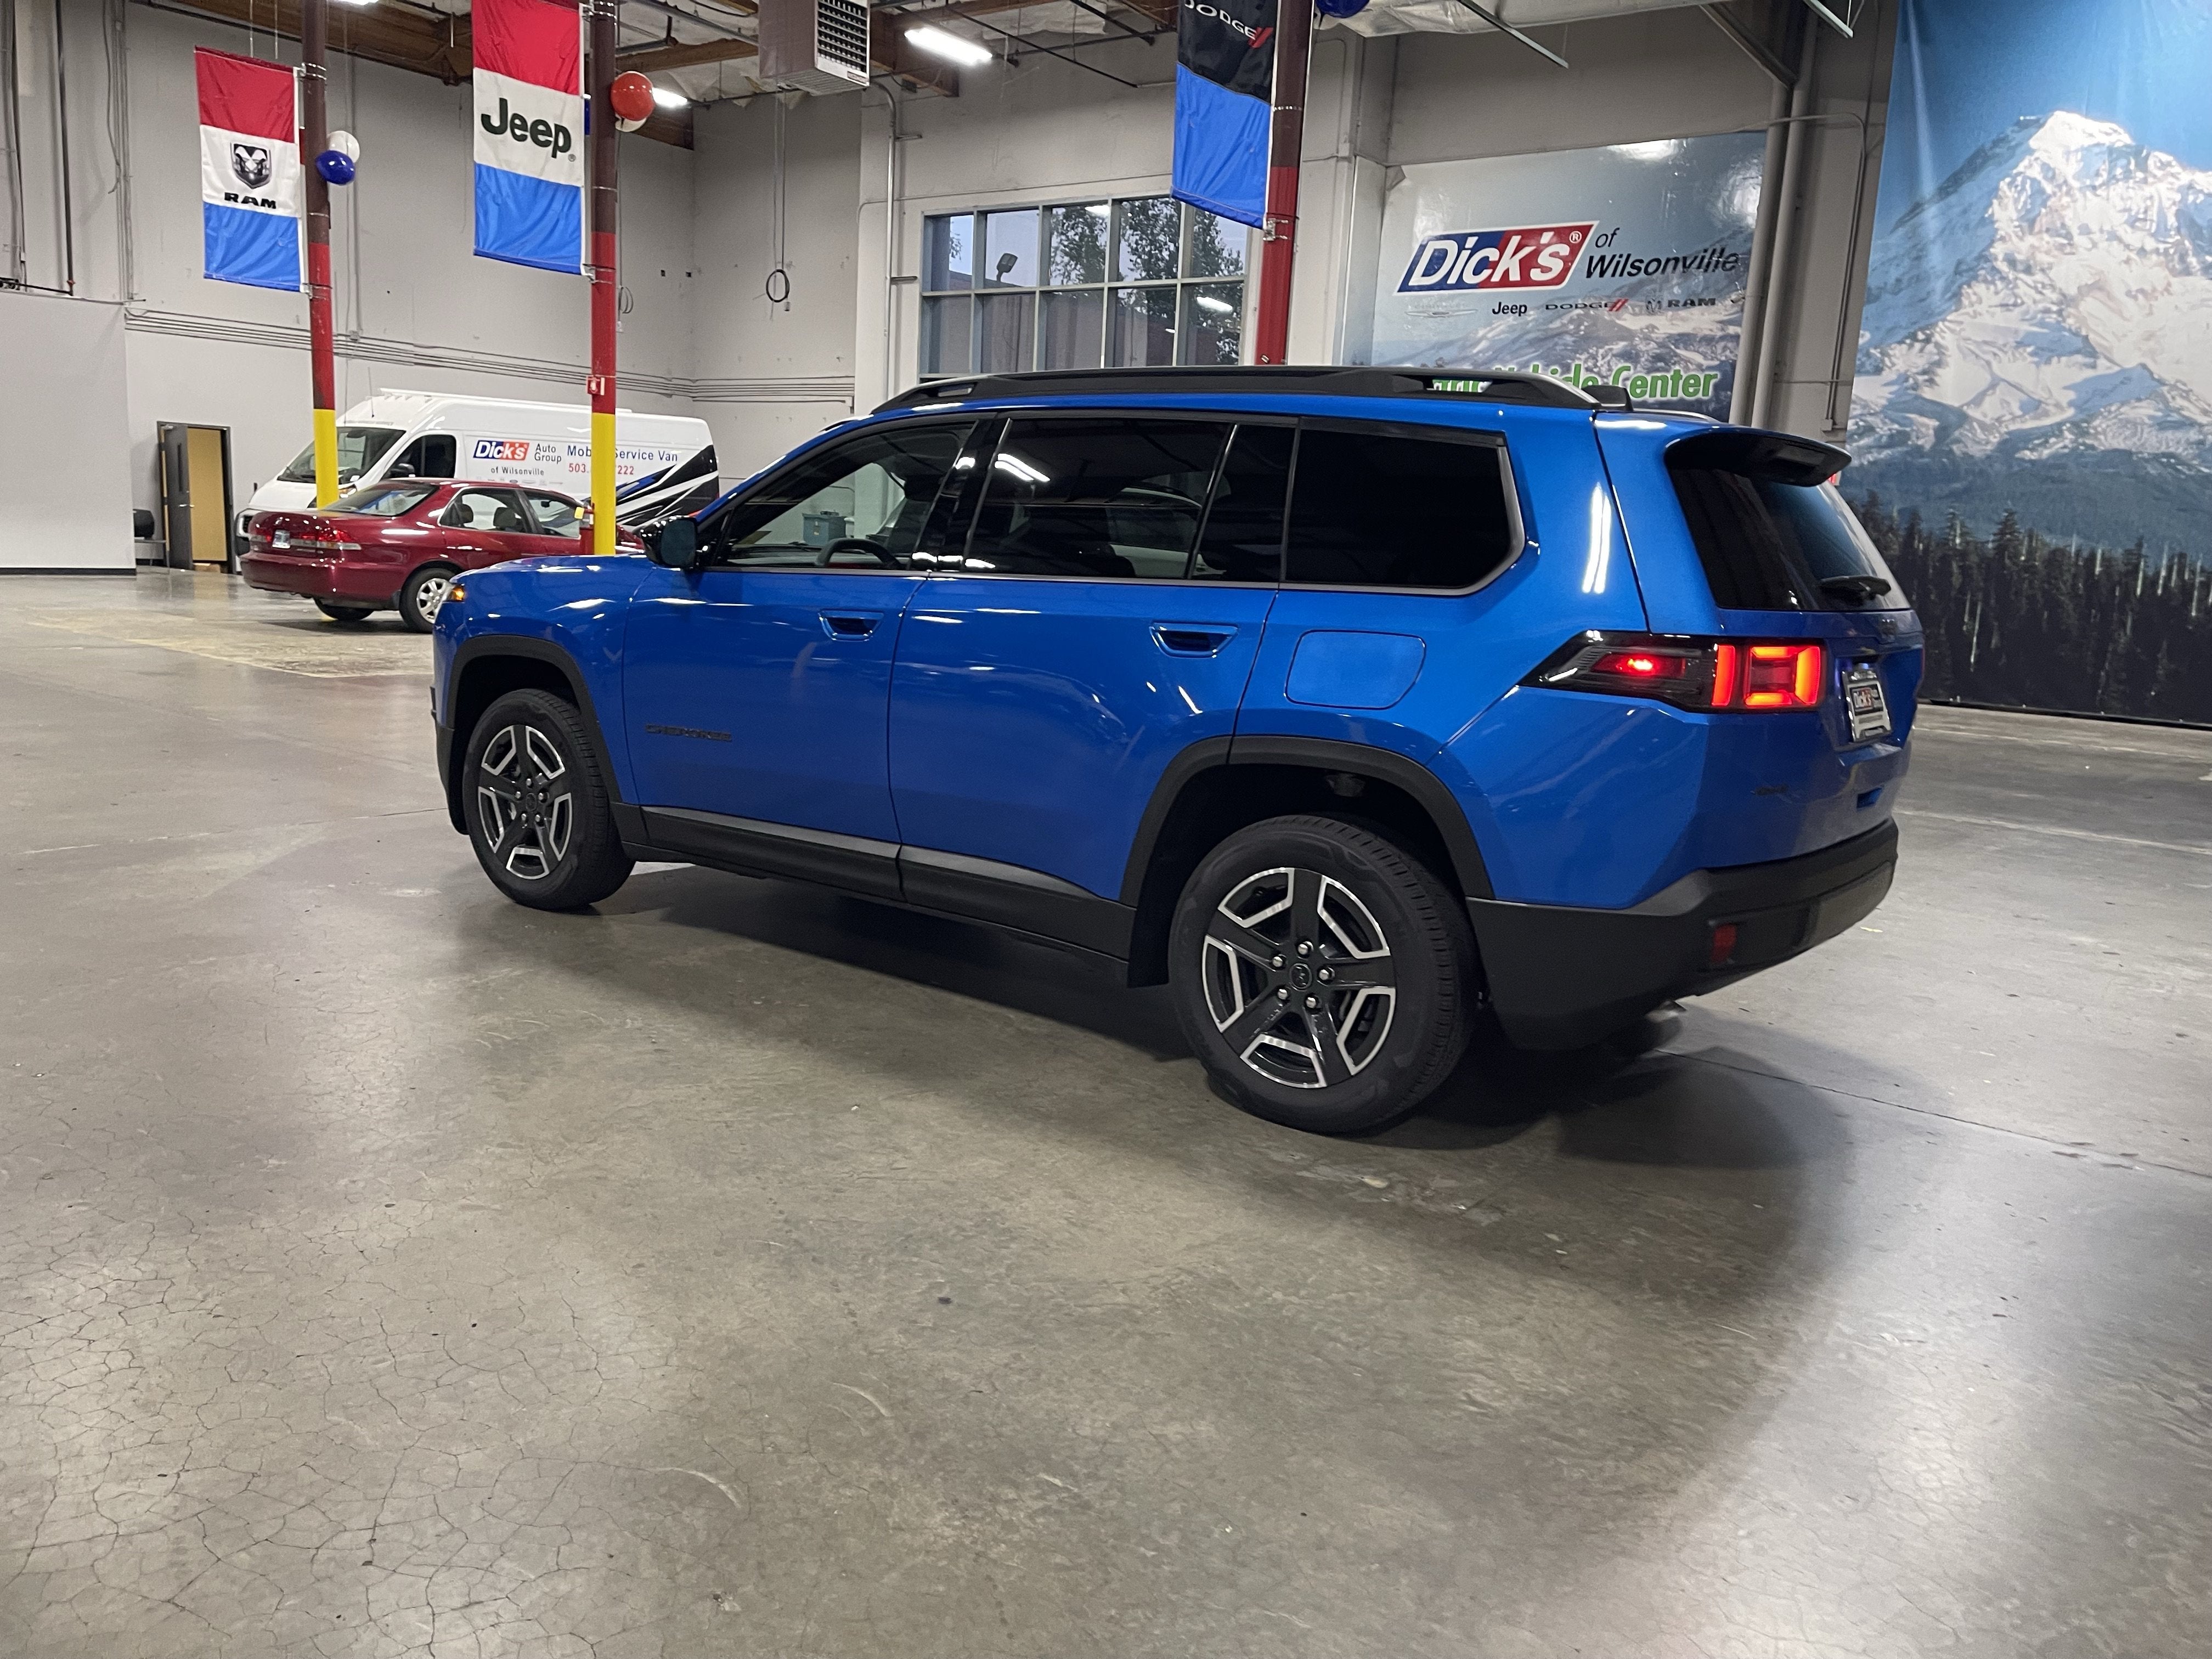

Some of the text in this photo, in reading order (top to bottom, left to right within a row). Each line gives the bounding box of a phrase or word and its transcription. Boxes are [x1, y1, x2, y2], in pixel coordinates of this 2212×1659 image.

[481, 98, 571, 159] Jeep
[224, 192, 276, 209] RAM
[1595, 227, 1620, 248] of
[1408, 232, 1571, 286] Dick's
[1585, 247, 1740, 279] Wilsonville
[1492, 302, 1527, 317] Jeep
[1667, 298, 1716, 308] RAM
[475, 441, 526, 460] Dick's
[535, 443, 556, 453] Auto
[658, 450, 678, 461] Van
[534, 452, 562, 464] Group
[502, 467, 544, 476] Wilsonville
